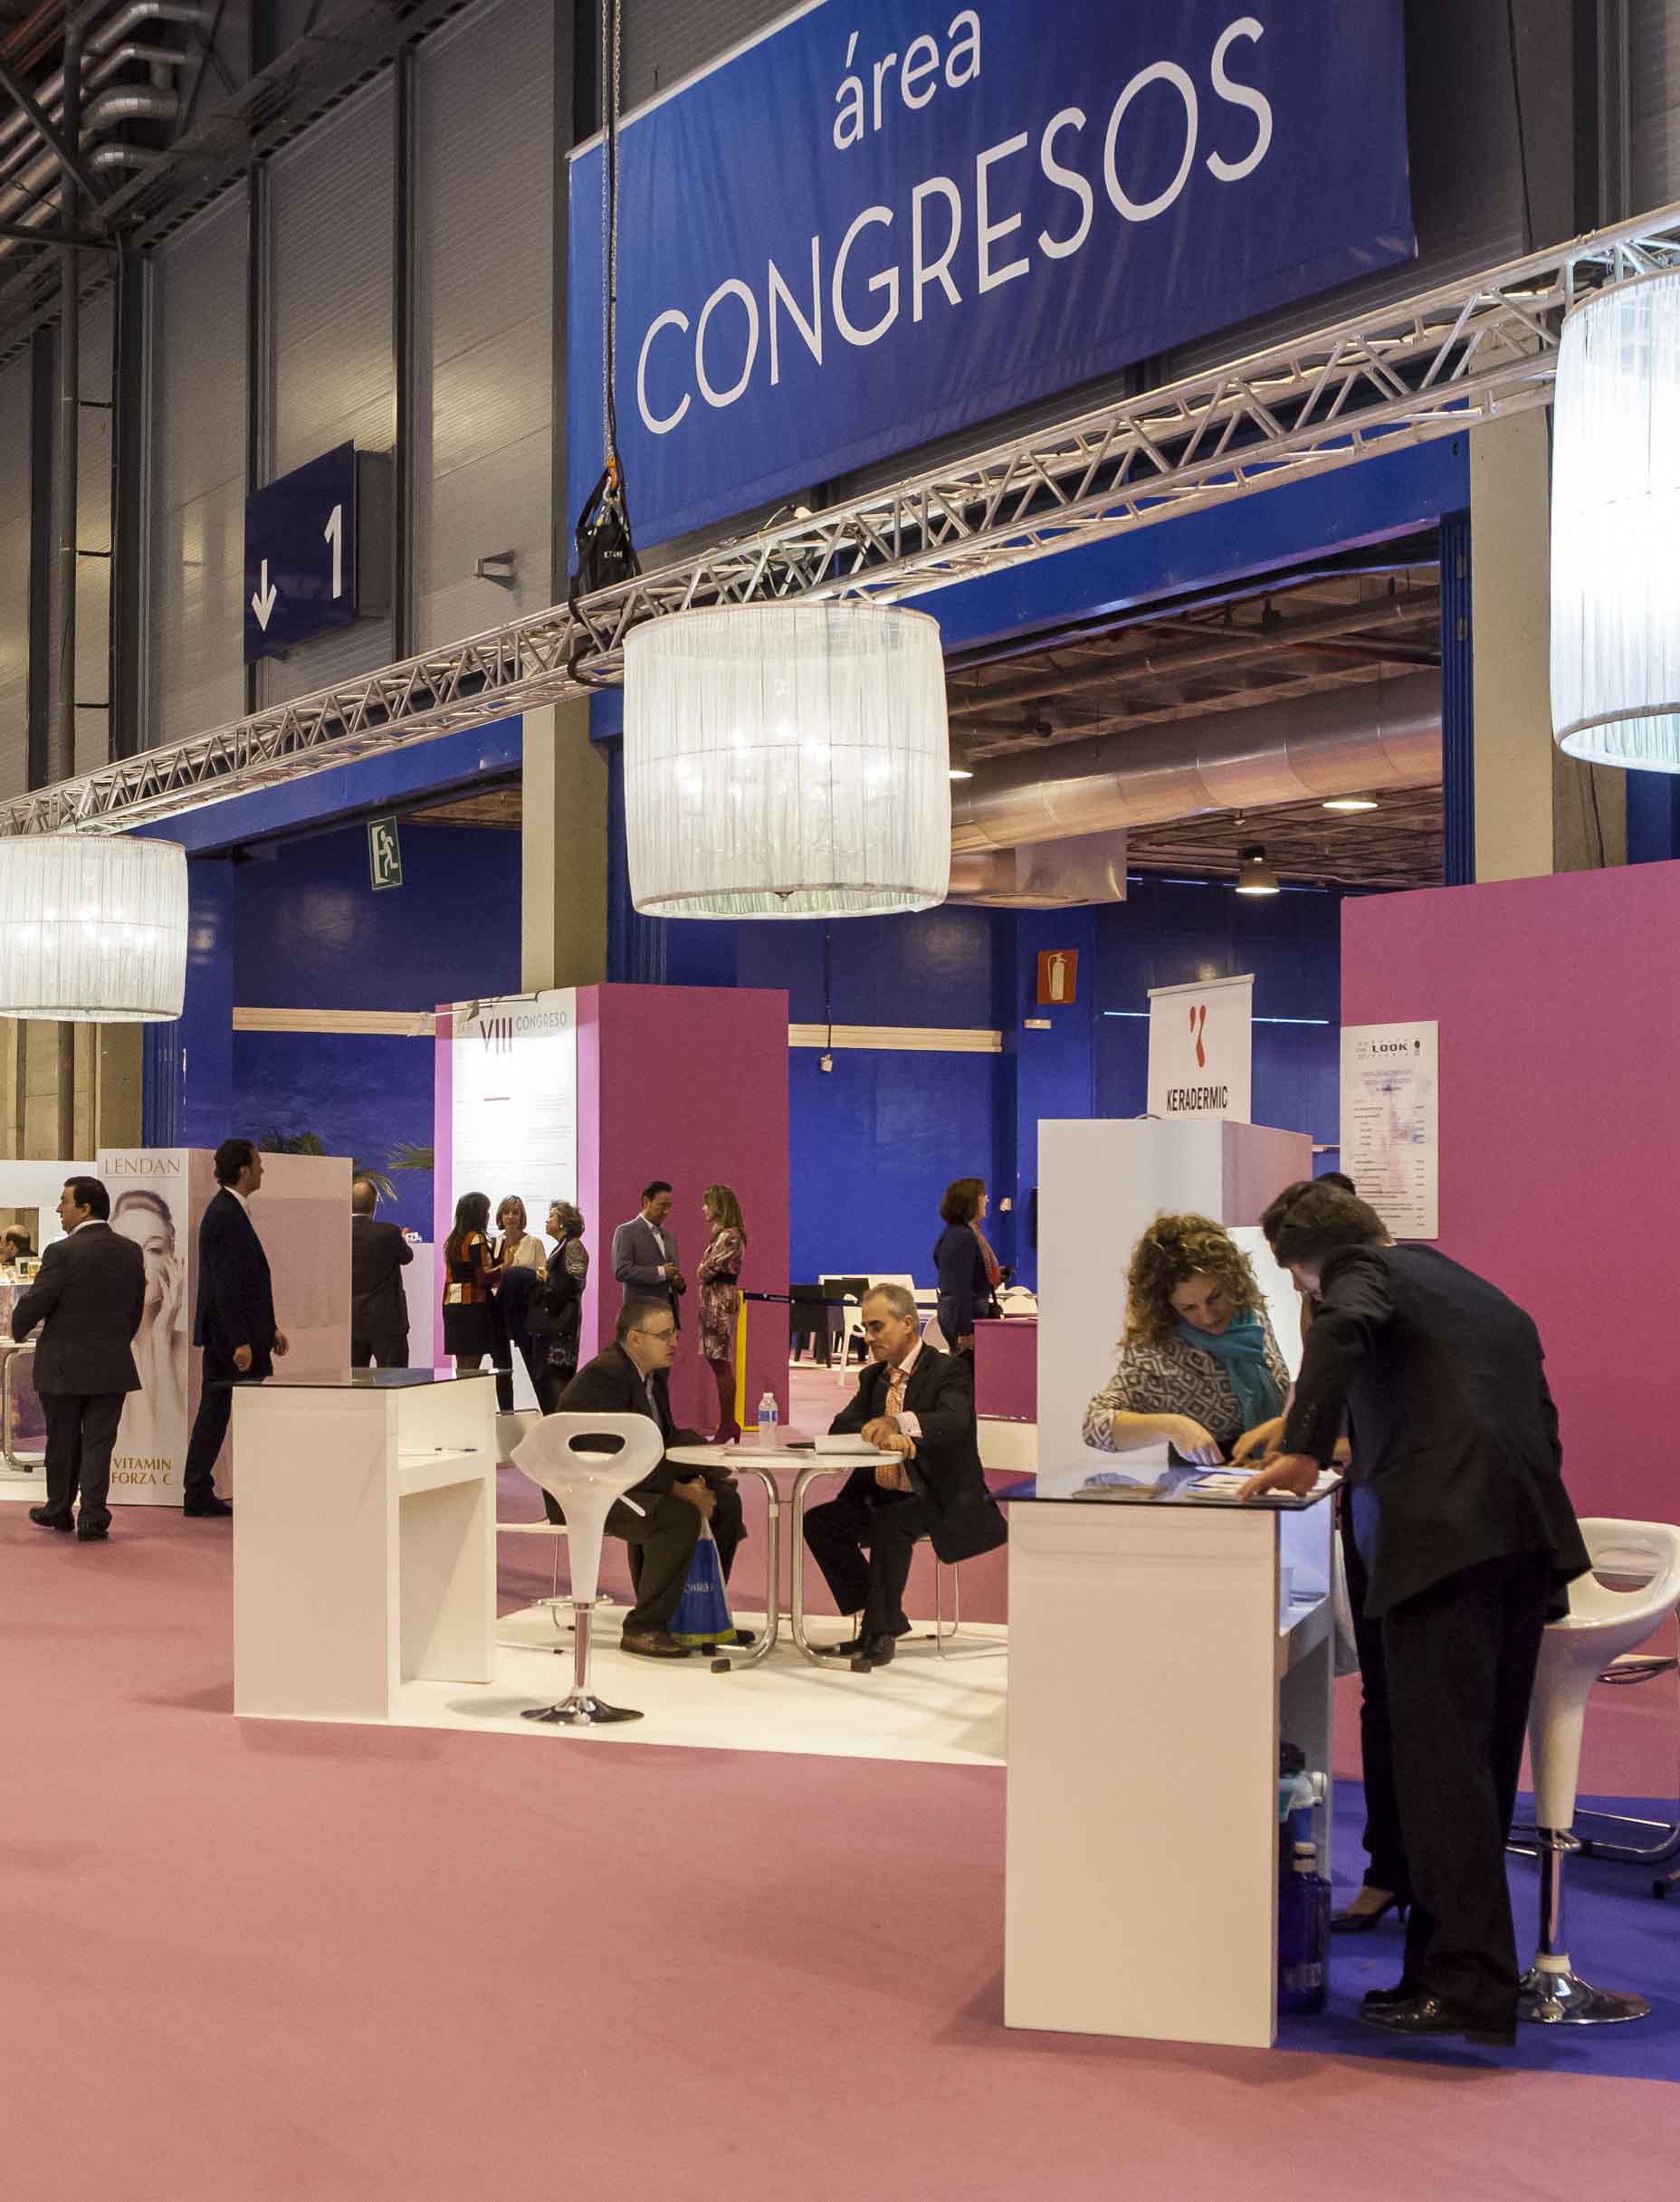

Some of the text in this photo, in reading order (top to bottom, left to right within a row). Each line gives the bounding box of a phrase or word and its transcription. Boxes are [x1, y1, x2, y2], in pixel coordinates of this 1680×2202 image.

[833, 9, 982, 150] área
[637, 16, 1273, 434] CONGRESOS
[324, 504, 342, 599] 1
[480, 1016, 512, 1054] VIII
[516, 1011, 567, 1030] CONGRESO
[1371, 1043, 1408, 1053] LOOK
[1167, 1085, 1228, 1111] KERADERMIC
[104, 1158, 180, 1174] LENDAN
[113, 1457, 171, 1470] VITAMIN
[111, 1472, 174, 1485] FORZA C
